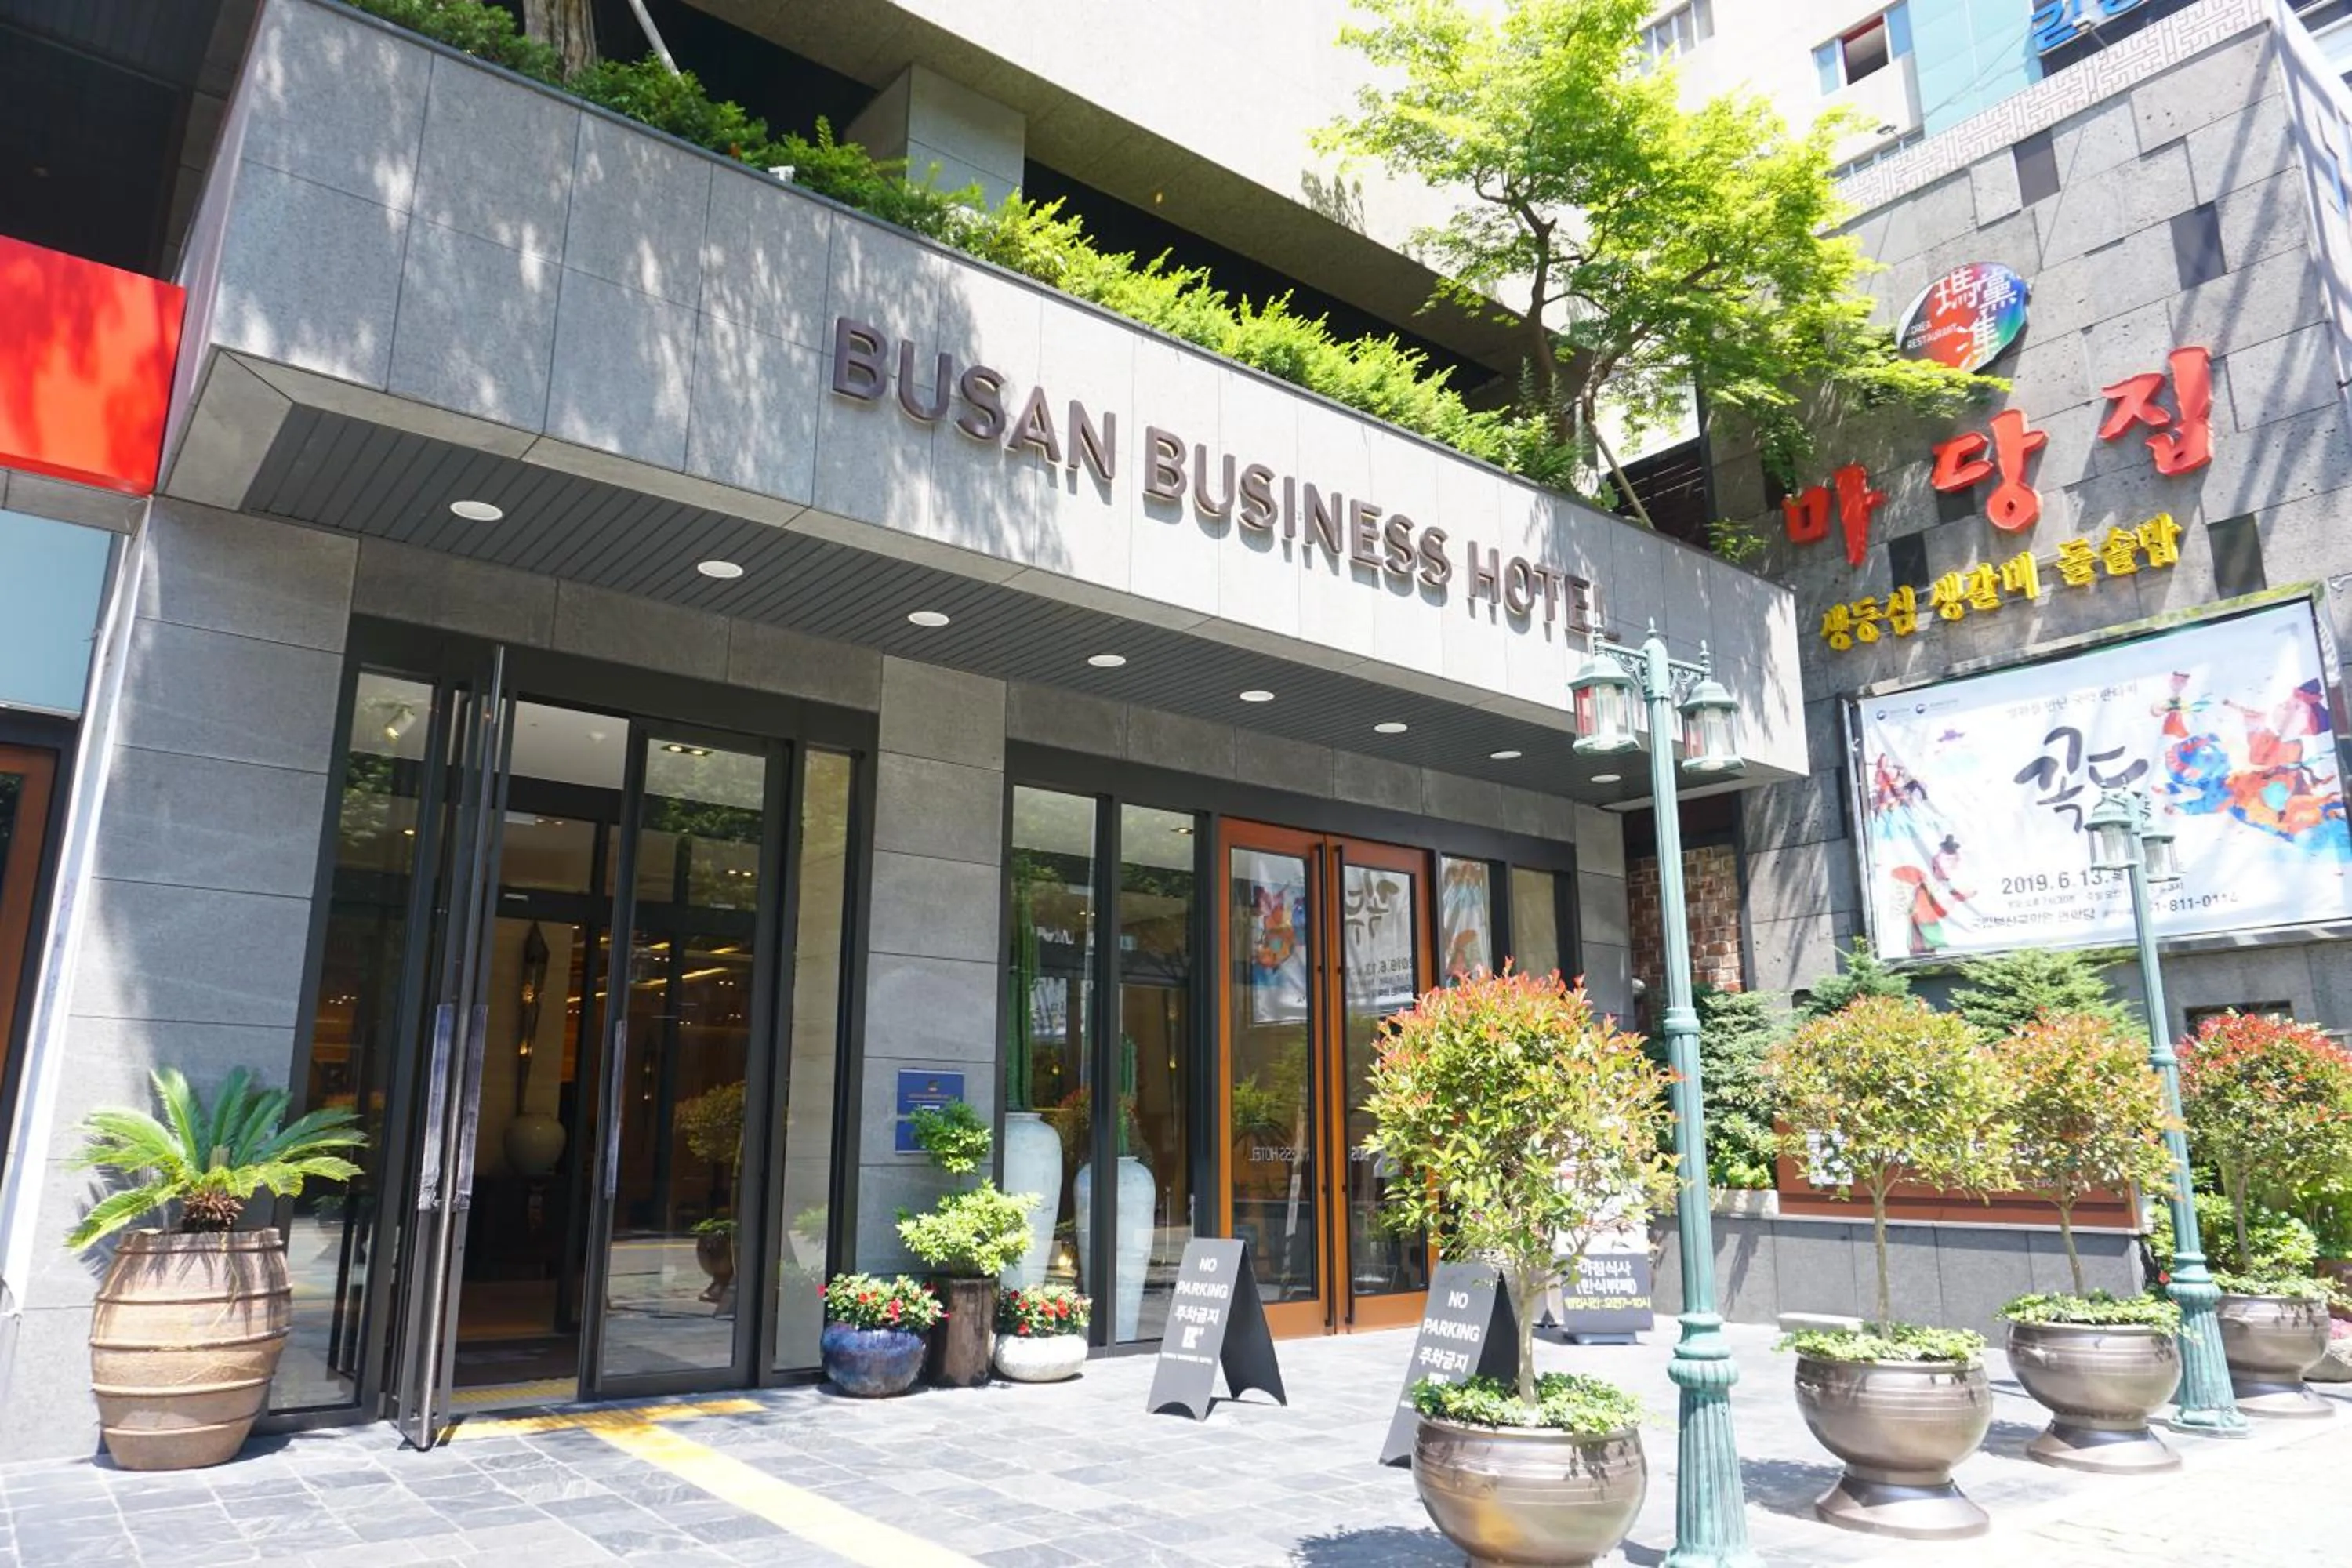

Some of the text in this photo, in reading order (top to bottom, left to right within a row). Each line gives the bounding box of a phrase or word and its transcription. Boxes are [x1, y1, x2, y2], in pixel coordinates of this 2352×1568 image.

[831, 316, 1116, 481] BUSAN
[1144, 426, 1452, 586] BUSINESS
[1783, 346, 2214, 567] 마당집
[1929, 551, 2040, 621] 생갈비
[1200, 1257, 1217, 1272] NO
[1578, 1259, 1632, 1277] 아침식사
[1177, 1279, 1229, 1298] PARKING
[1448, 1290, 1468, 1308] NO
[1174, 1305, 1219, 1325] 주차금지
[1422, 1317, 1480, 1342] PARKING
[1419, 1345, 1468, 1373] 주차금지
